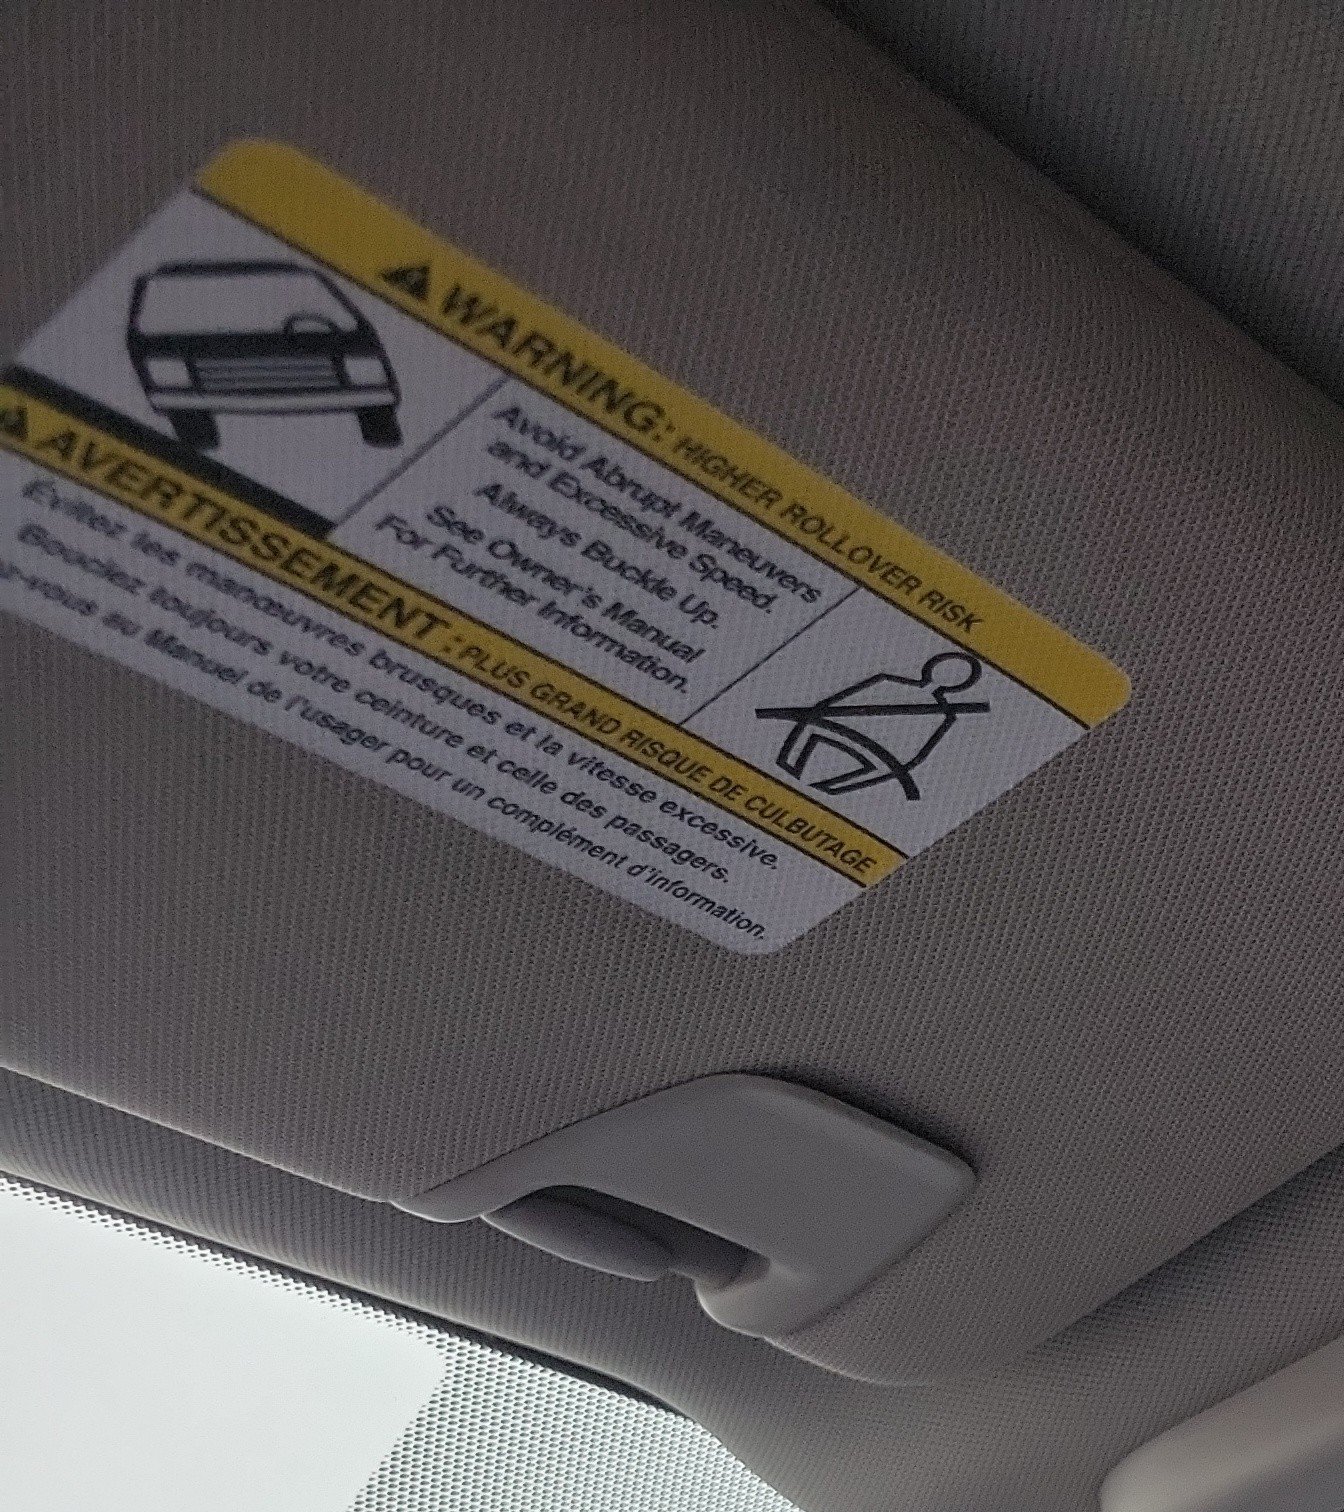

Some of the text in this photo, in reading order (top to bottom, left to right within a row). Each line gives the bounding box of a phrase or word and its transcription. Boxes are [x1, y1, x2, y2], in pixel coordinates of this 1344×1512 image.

[441, 284, 985, 635] WARNING: HIGHER ROLLOVER RISK
[474, 483, 719, 629] Always Buckle Up.
[488, 441, 778, 614] and Excessive Speed.
[489, 404, 822, 603] Avoid Abrupt Maneuvers
[376, 512, 691, 693] For Further Information.
[427, 505, 706, 663] See Owner's Manual
[145, 628, 249, 685] Manuel
[246, 680, 283, 704] de
[387, 747, 453, 783] pour
[451, 776, 486, 801] un
[487, 796, 629, 869] complément
[627, 862, 765, 940] d'information.
[279, 650, 350, 693] votre
[355, 689, 465, 749] ceinture
[466, 744, 498, 765] et
[496, 759, 559, 795] celle
[560, 790, 608, 819] des
[604, 814, 729, 884] passagers.
[369, 650, 501, 725] brusques
[505, 721, 538, 742] et
[534, 735, 564, 757] la
[567, 751, 657, 803] vitesse
[659, 800, 778, 870] excessive.
[458, 645, 531, 688] PLUS
[530, 682, 621, 735] GRAND
[620, 729, 713, 784] RISQUE
[709, 775, 750, 801] DE
[745, 794, 878, 874] CULBUTAGE
